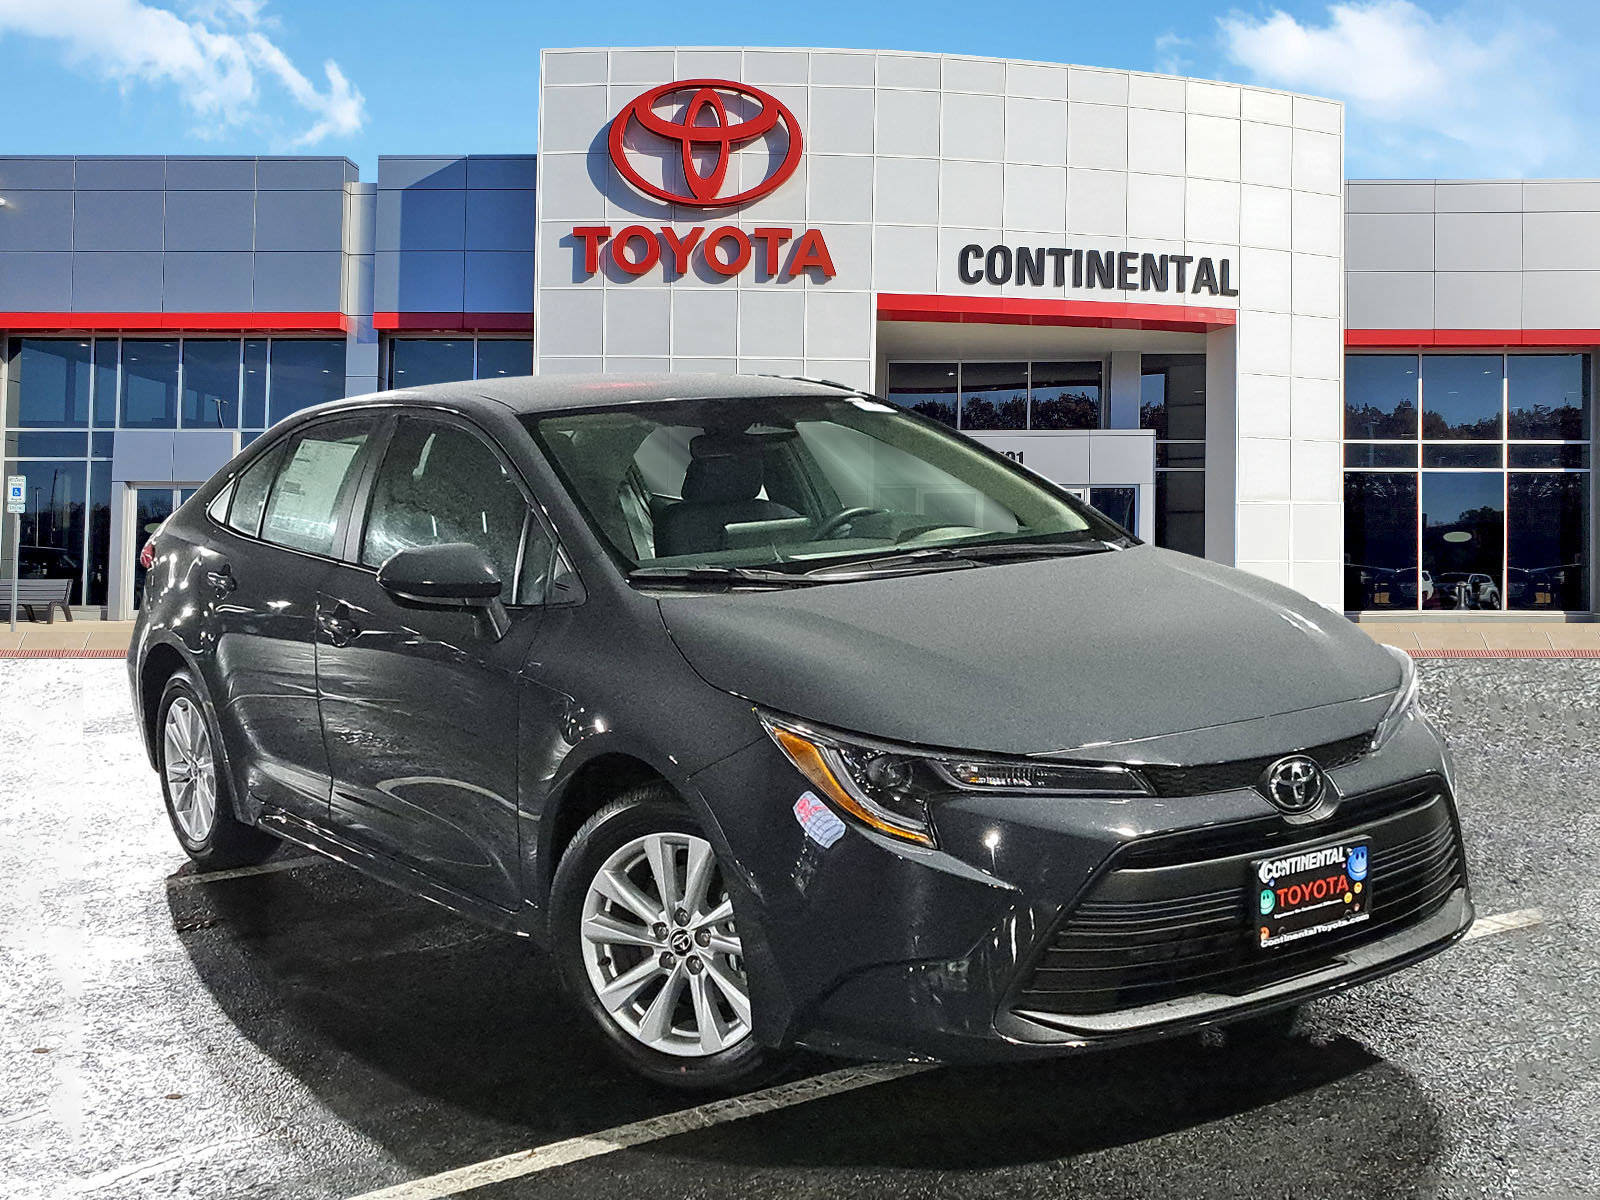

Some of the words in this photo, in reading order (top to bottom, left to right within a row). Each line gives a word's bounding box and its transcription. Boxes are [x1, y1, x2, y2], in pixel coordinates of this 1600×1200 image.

[572, 225, 836, 277] TOYOTA
[958, 244, 1239, 297] CONTINENTAL
[1258, 846, 1346, 884] CONTINENTAL
[1276, 874, 1349, 907] TOYOTA
